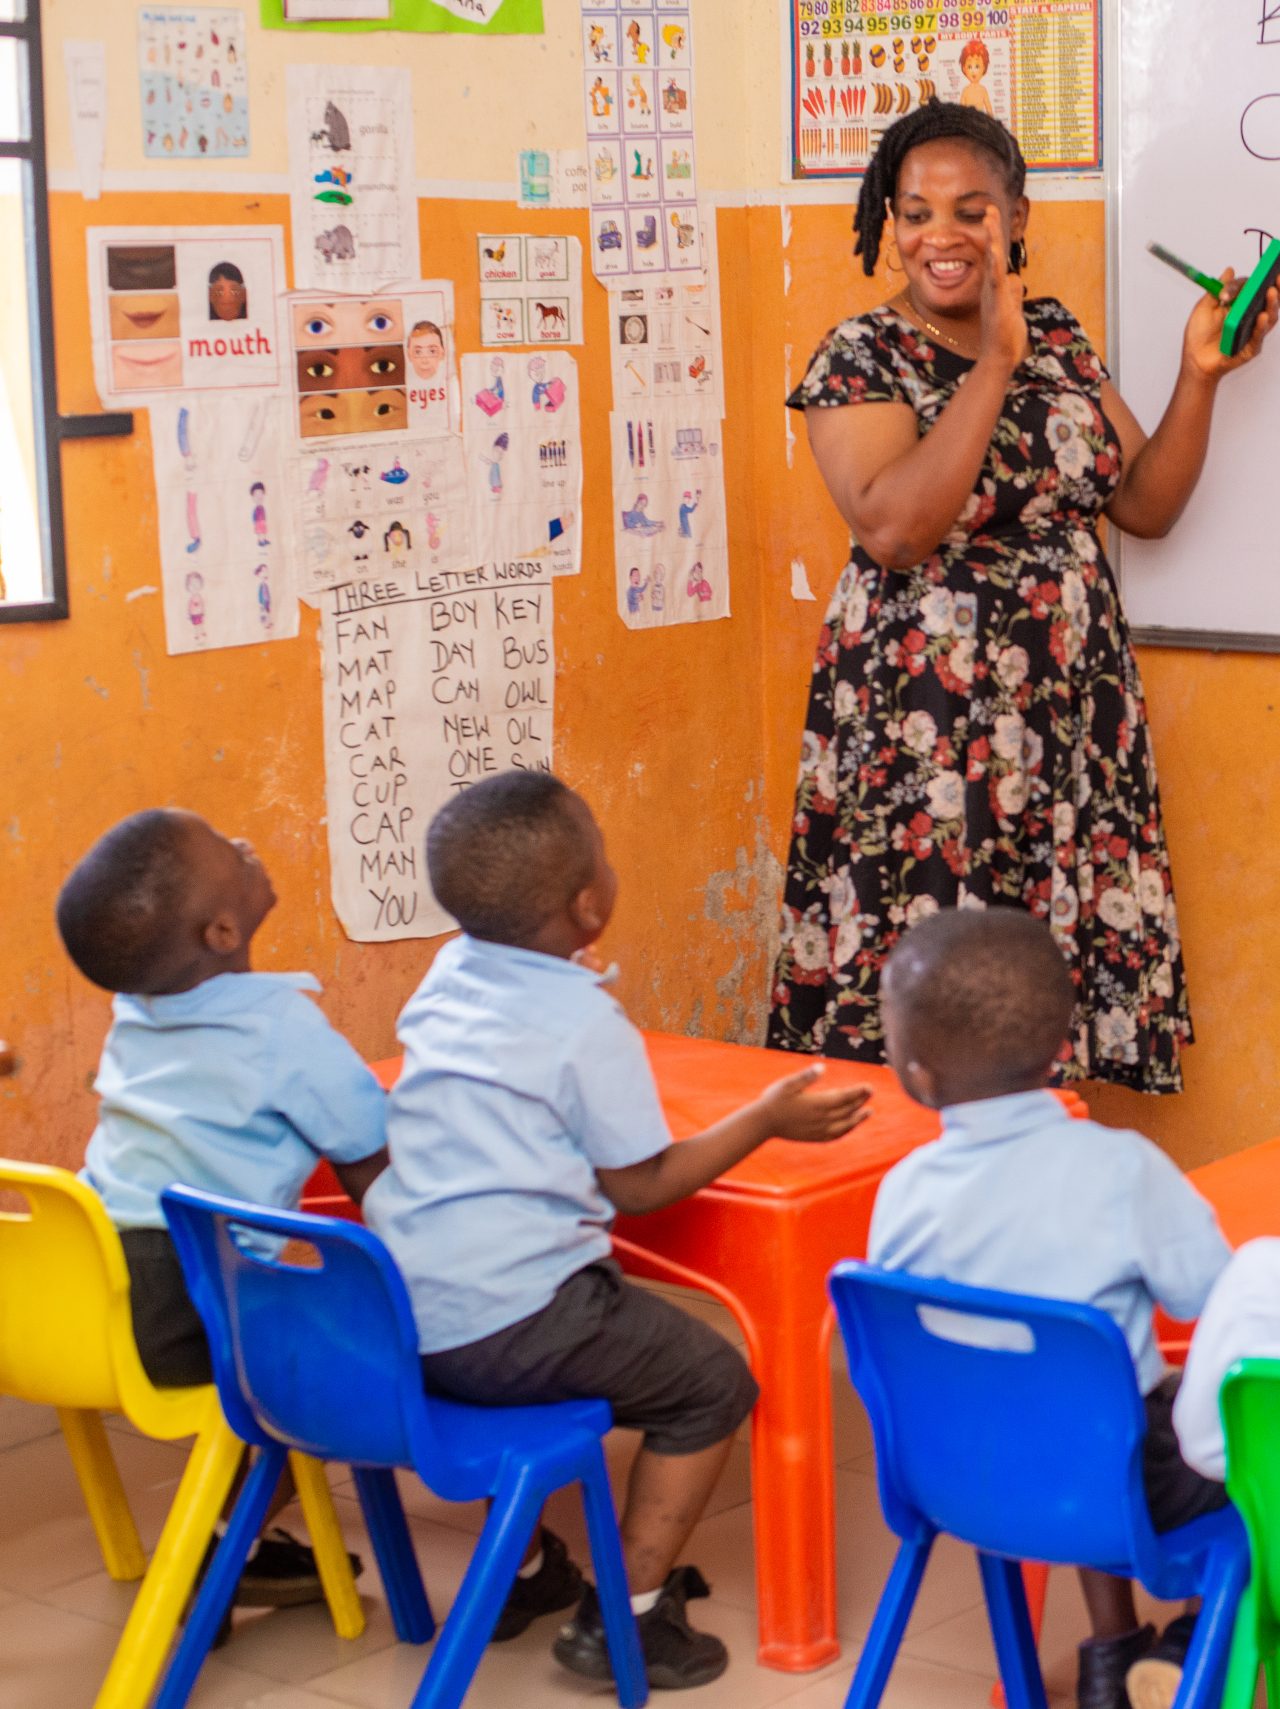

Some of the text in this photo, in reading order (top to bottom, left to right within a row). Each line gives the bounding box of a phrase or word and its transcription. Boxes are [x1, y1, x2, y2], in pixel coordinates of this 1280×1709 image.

[800, 2, 813, 16] 79
[815, 1, 829, 15] 80
[831, 0, 844, 14] 81
[846, 0, 860, 13] 82
[861, 0, 876, 12] 83
[877, 0, 891, 11] 84
[801, 10, 1008, 36] 92 93 94 95 96 97 98 99 100
[359, 124, 388, 136] gorilla
[485, 270, 517, 279] chicken
[189, 328, 271, 357] mouth
[409, 386, 446, 409] eyes
[329, 561, 544, 613] THREE LETTER WORDS
[430, 601, 479, 631] BOY
[495, 591, 543, 629] KEY
[334, 615, 390, 654] FAN
[337, 650, 393, 686] MAT
[430, 639, 475, 673] DAY
[502, 636, 549, 670] BUS
[339, 680, 397, 718] MAP
[432, 676, 480, 704] CAN
[504, 681, 548, 709] OWL
[340, 717, 396, 748] CAT
[443, 715, 491, 743] NEW
[506, 716, 542, 745] OIL
[350, 746, 406, 779] CAR
[448, 747, 498, 777] ONE
[353, 774, 407, 807] CUP
[351, 807, 413, 845] CAP
[360, 846, 416, 884] MAN
[369, 887, 417, 930] YOU
